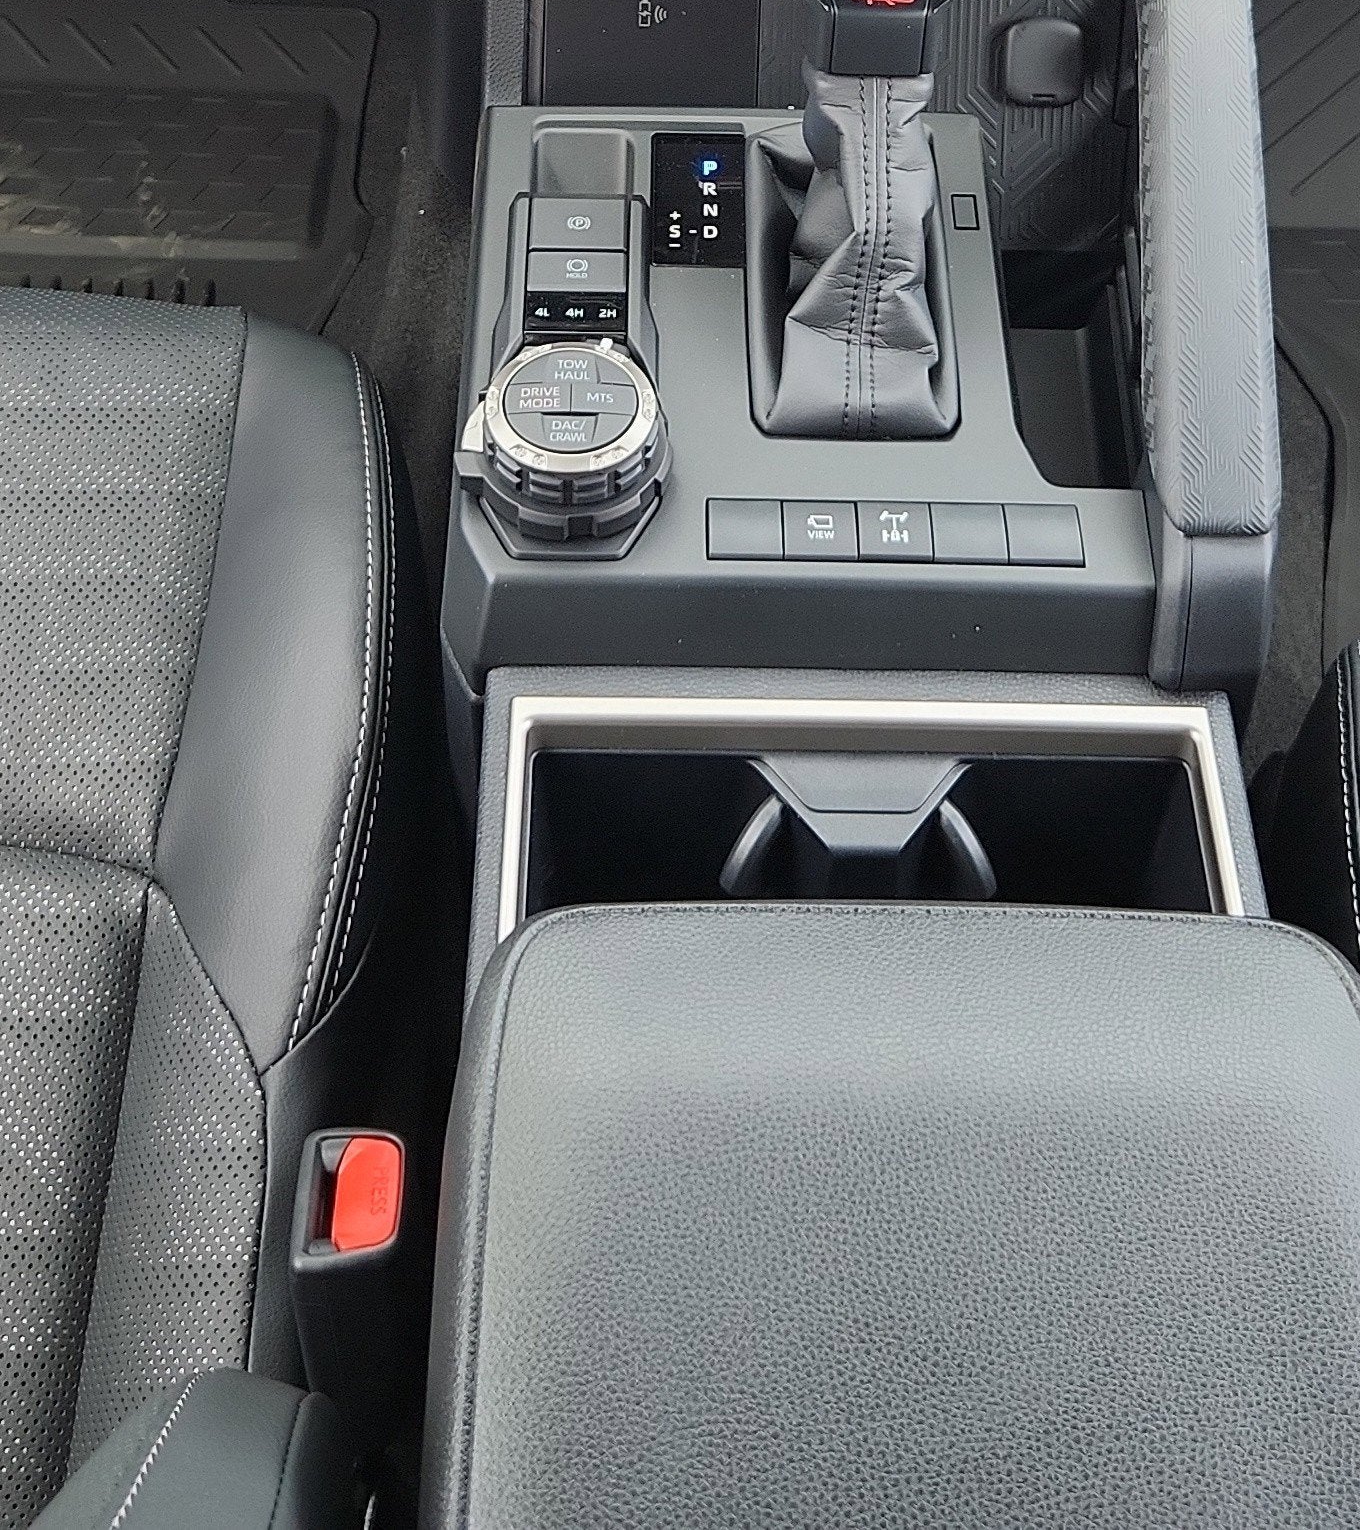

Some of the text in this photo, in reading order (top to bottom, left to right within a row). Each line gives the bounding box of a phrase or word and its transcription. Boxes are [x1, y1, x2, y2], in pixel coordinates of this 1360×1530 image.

[703, 160, 718, 175] P
[703, 182, 718, 196] R
[703, 204, 718, 217] N
[668, 224, 718, 238] S D
[535, 307, 617, 318] 4L 4H 2H
[557, 359, 588, 369] TOW
[554, 371, 590, 380] HAUL
[521, 386, 560, 397] DRIVE
[519, 398, 561, 408] MODE
[587, 392, 614, 403] MTS
[552, 420, 586, 431] DAC/
[550, 432, 587, 442] CRAWL
[808, 530, 835, 539] VIEW
[369, 1165, 390, 1218] PRESS
